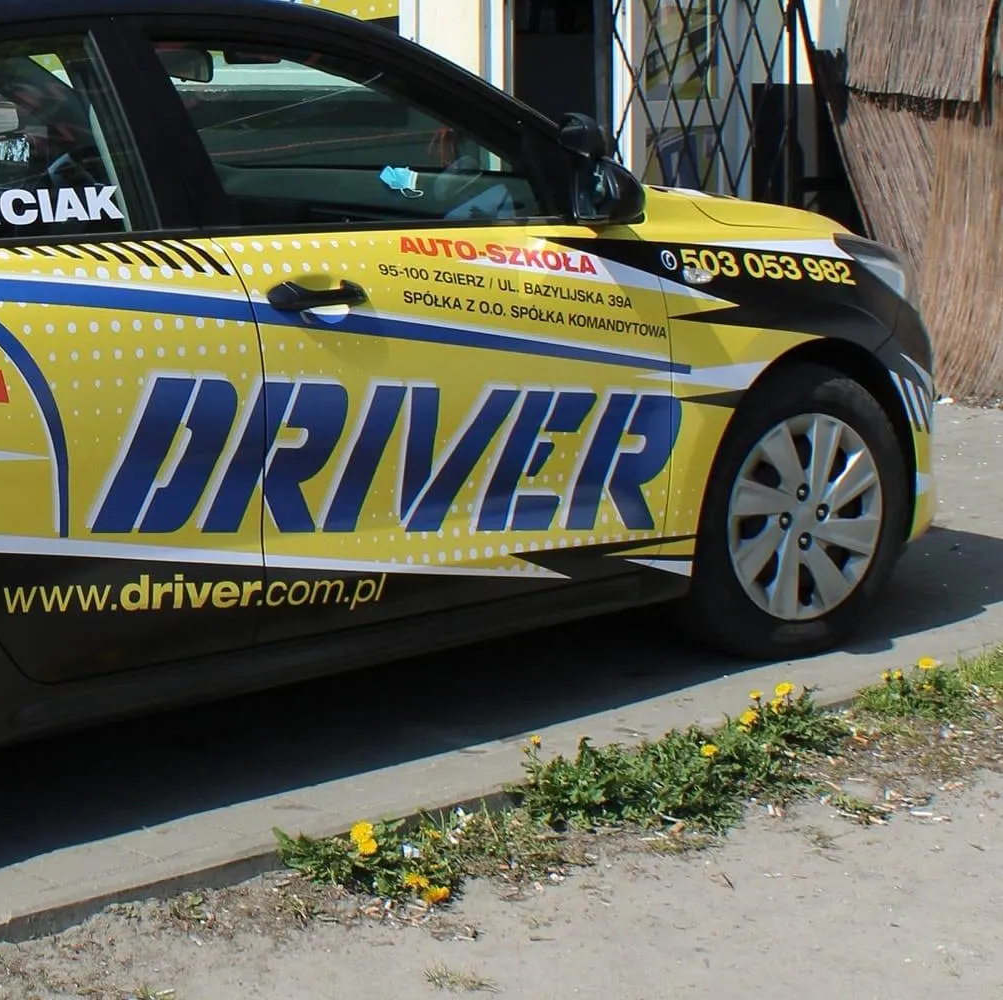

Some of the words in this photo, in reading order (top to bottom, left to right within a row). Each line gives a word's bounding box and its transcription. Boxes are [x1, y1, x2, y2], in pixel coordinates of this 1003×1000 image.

[400, 235, 597, 275] AUTO-SZKOŁA
[680, 248, 740, 279] 503
[742, 253, 803, 282] 053
[806, 257, 856, 287] 982
[378, 262, 429, 281] 95-100
[434, 270, 485, 288] ZGIERZ
[498, 279, 520, 293] UL.
[524, 282, 605, 306] BAZYLIJSKA
[608, 294, 632, 310] 39A
[403, 289, 462, 311] SPÓŁKA
[466, 299, 475, 313] Z
[479, 301, 506, 317] O.O.
[510, 304, 565, 326] SPÓŁKA
[568, 314, 667, 340] KOMANDYTOWA
[87, 372, 683, 534] DRIVER
[4, 573, 387, 615] www.driver.com.pl
